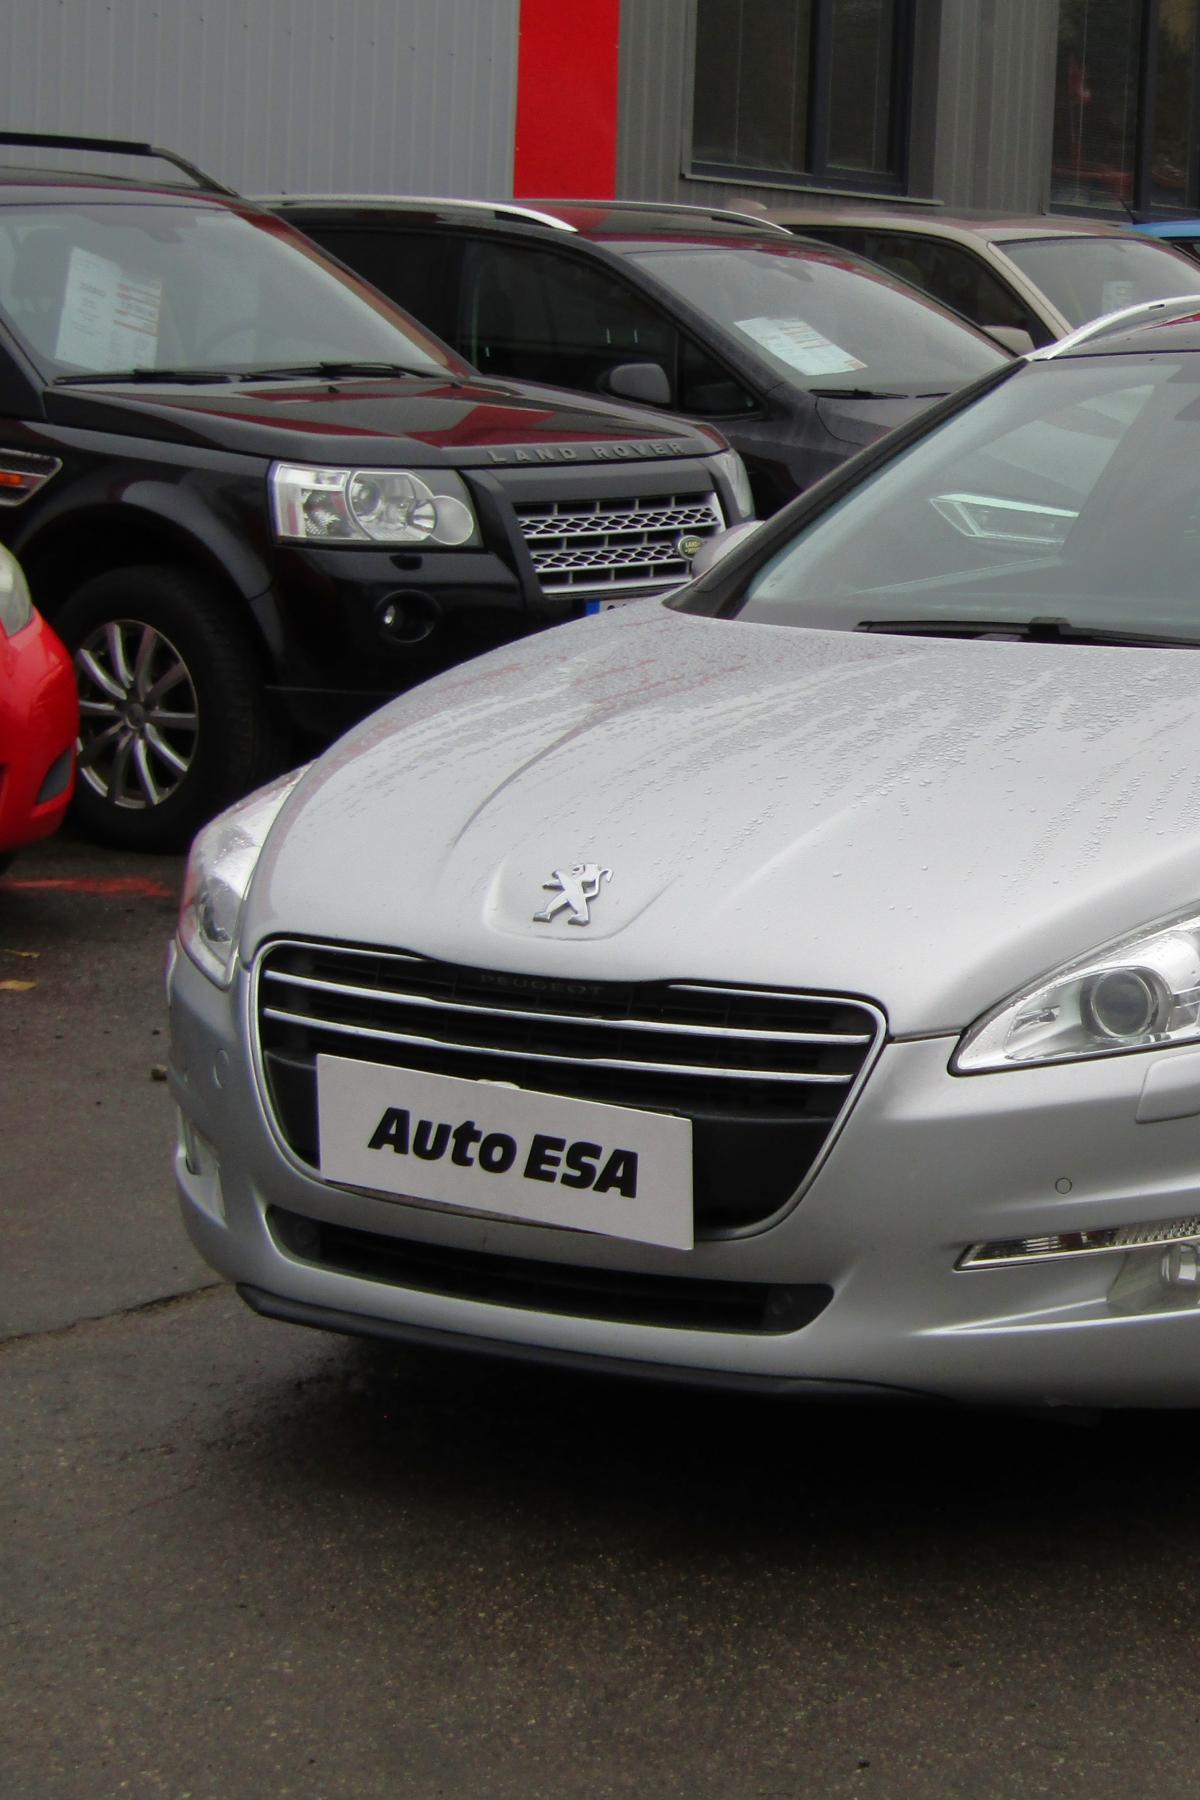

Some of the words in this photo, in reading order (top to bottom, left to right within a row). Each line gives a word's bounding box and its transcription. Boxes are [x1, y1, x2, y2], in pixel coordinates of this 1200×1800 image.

[487, 447, 577, 464] LAND
[591, 441, 686, 459] ROVER
[480, 974, 606, 996] PEUGEOT
[367, 1106, 518, 1174] Auto
[523, 1133, 639, 1199] ESA
